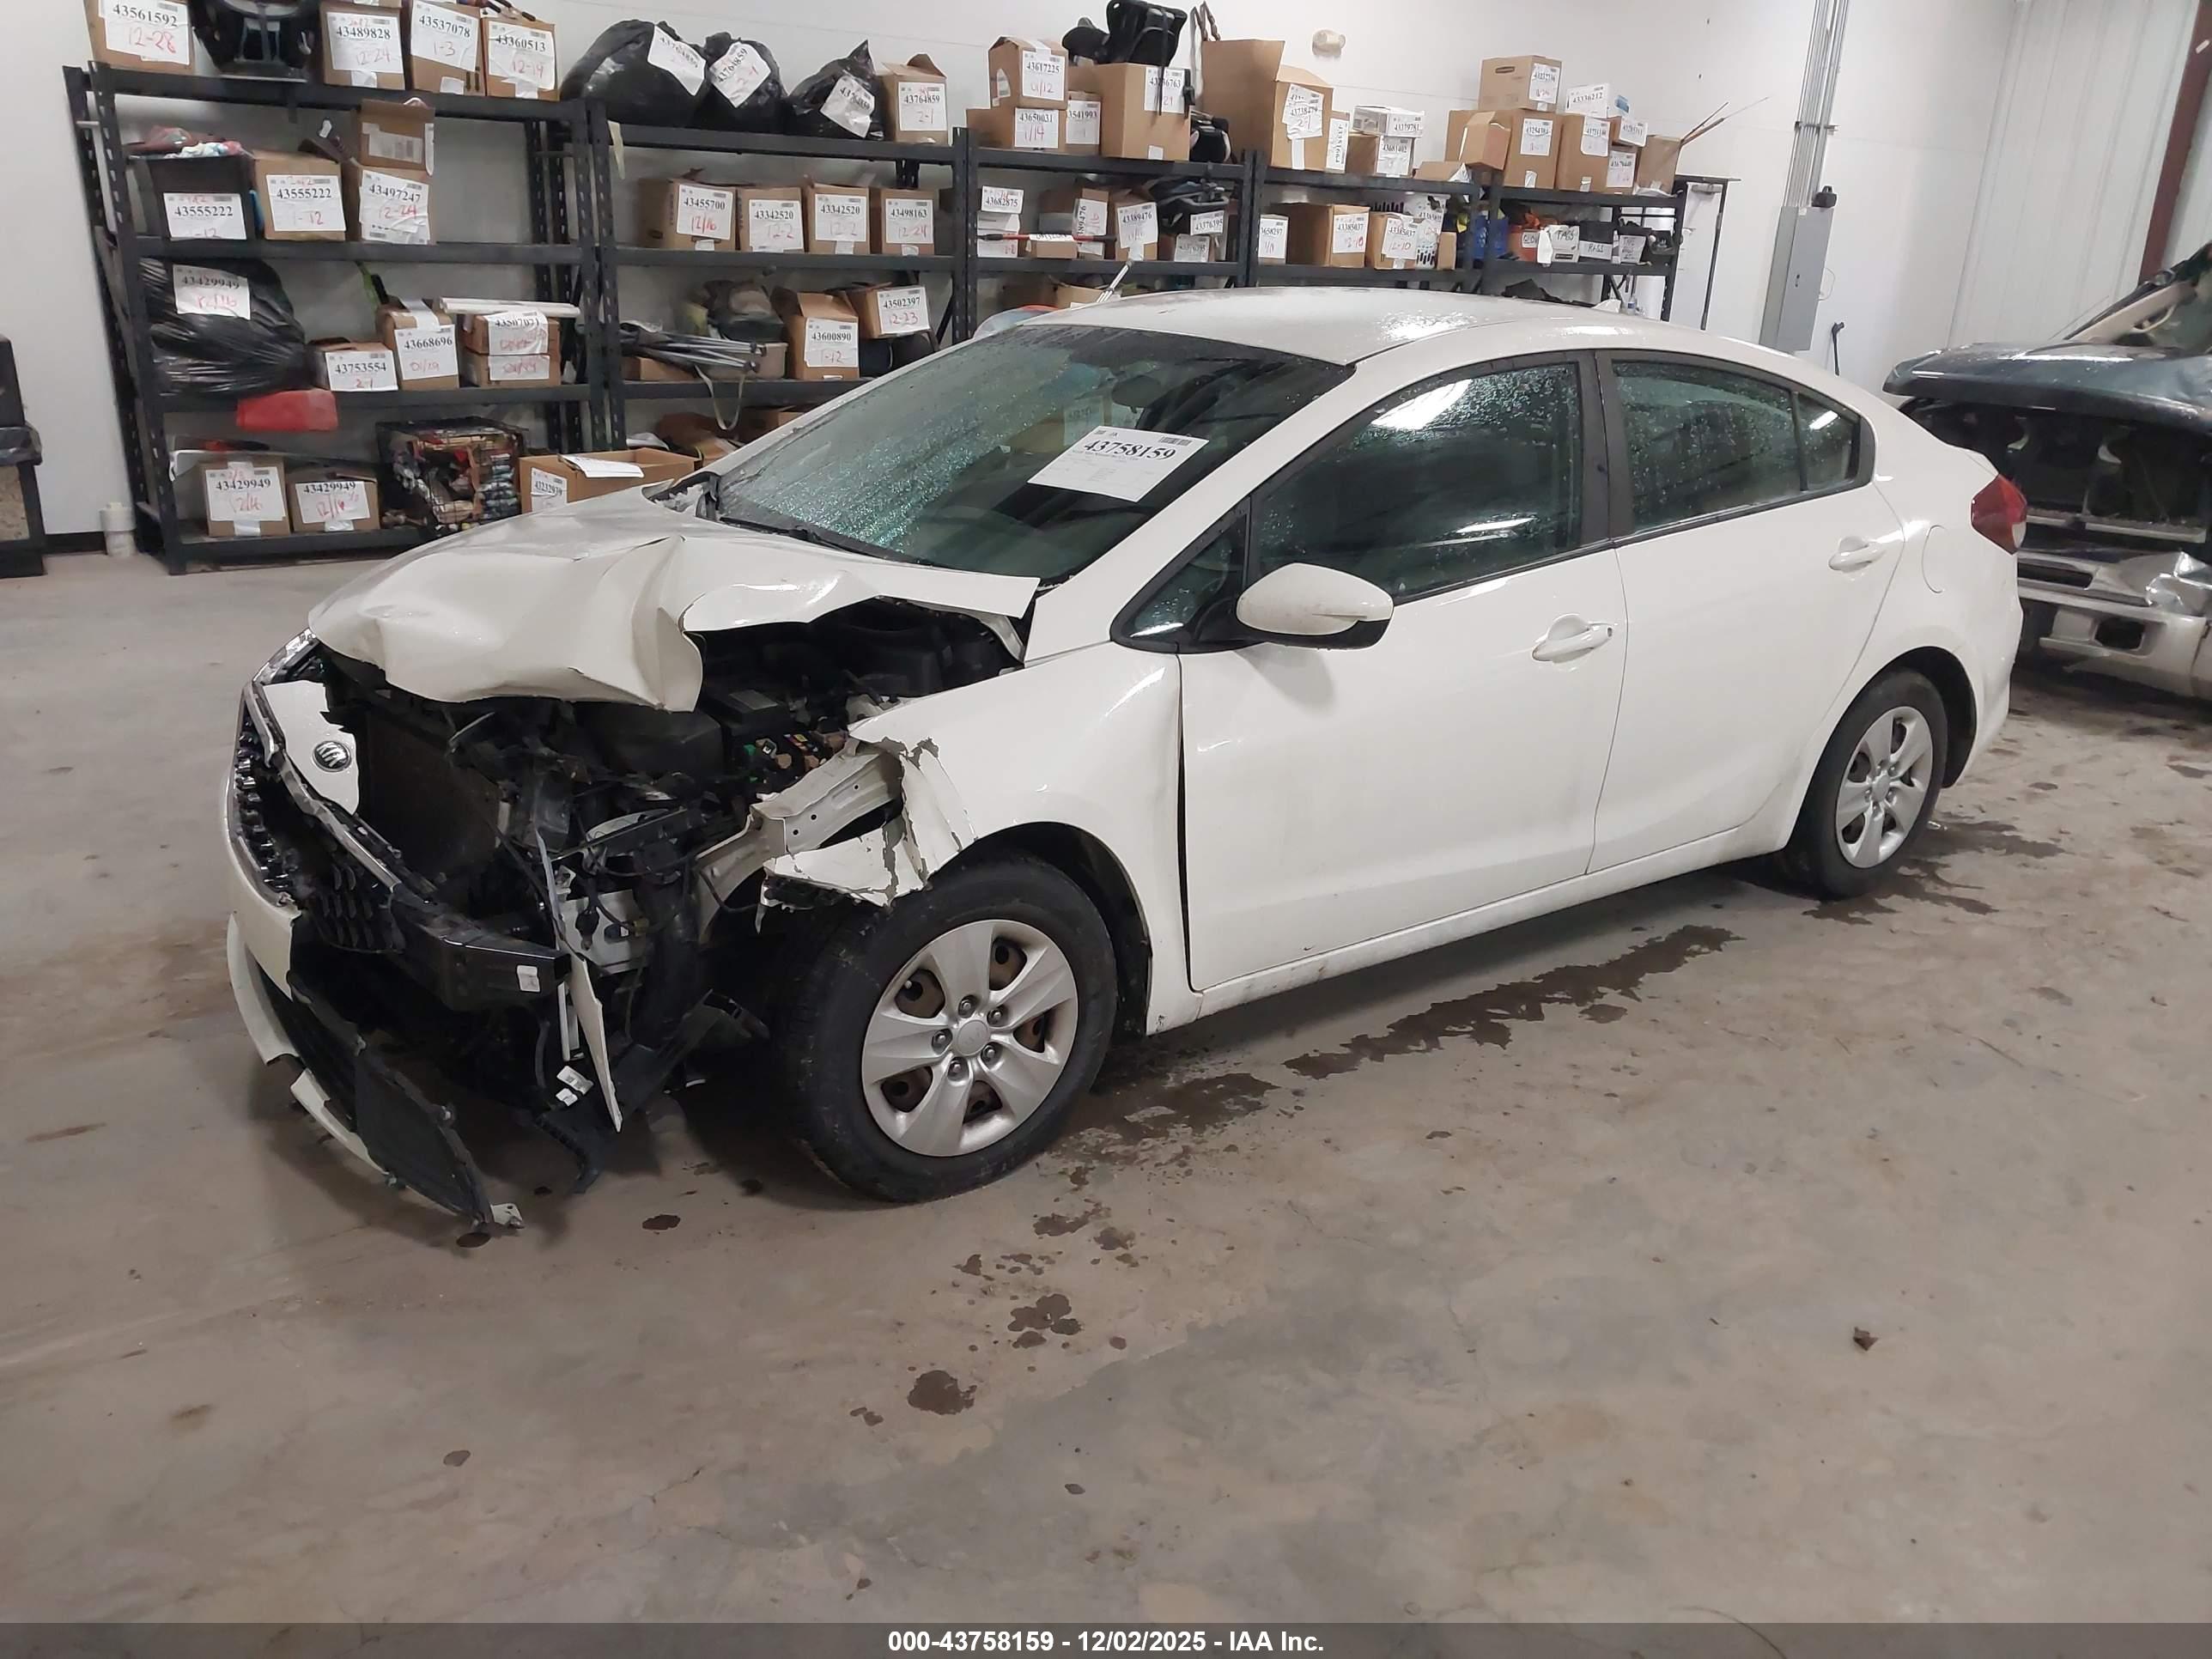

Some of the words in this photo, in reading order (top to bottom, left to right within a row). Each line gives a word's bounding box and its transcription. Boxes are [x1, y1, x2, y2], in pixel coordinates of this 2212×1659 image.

[112, 3, 178, 27] 43561592
[419, 15, 471, 38] 43537078
[336, 26, 391, 40] 43489828
[495, 34, 546, 52] 43360513
[904, 94, 940, 104] 43764859
[1069, 110, 1097, 118] 3541993
[276, 187, 332, 199] 43555222
[369, 184, 421, 203] 43497247
[684, 197, 726, 210] 43455700
[821, 204, 860, 215] 43342520
[174, 205, 234, 216] 43555222
[755, 210, 794, 220] 43342520
[890, 208, 927, 218] 43498163
[883, 297, 921, 309] 43502397
[811, 331, 852, 342] 43600890
[404, 337, 453, 349] 43668696
[335, 362, 386, 374] 43753554
[1085, 439, 1176, 460] 43758159
[216, 478, 271, 490] 43429949
[303, 481, 356, 494] 43429949
